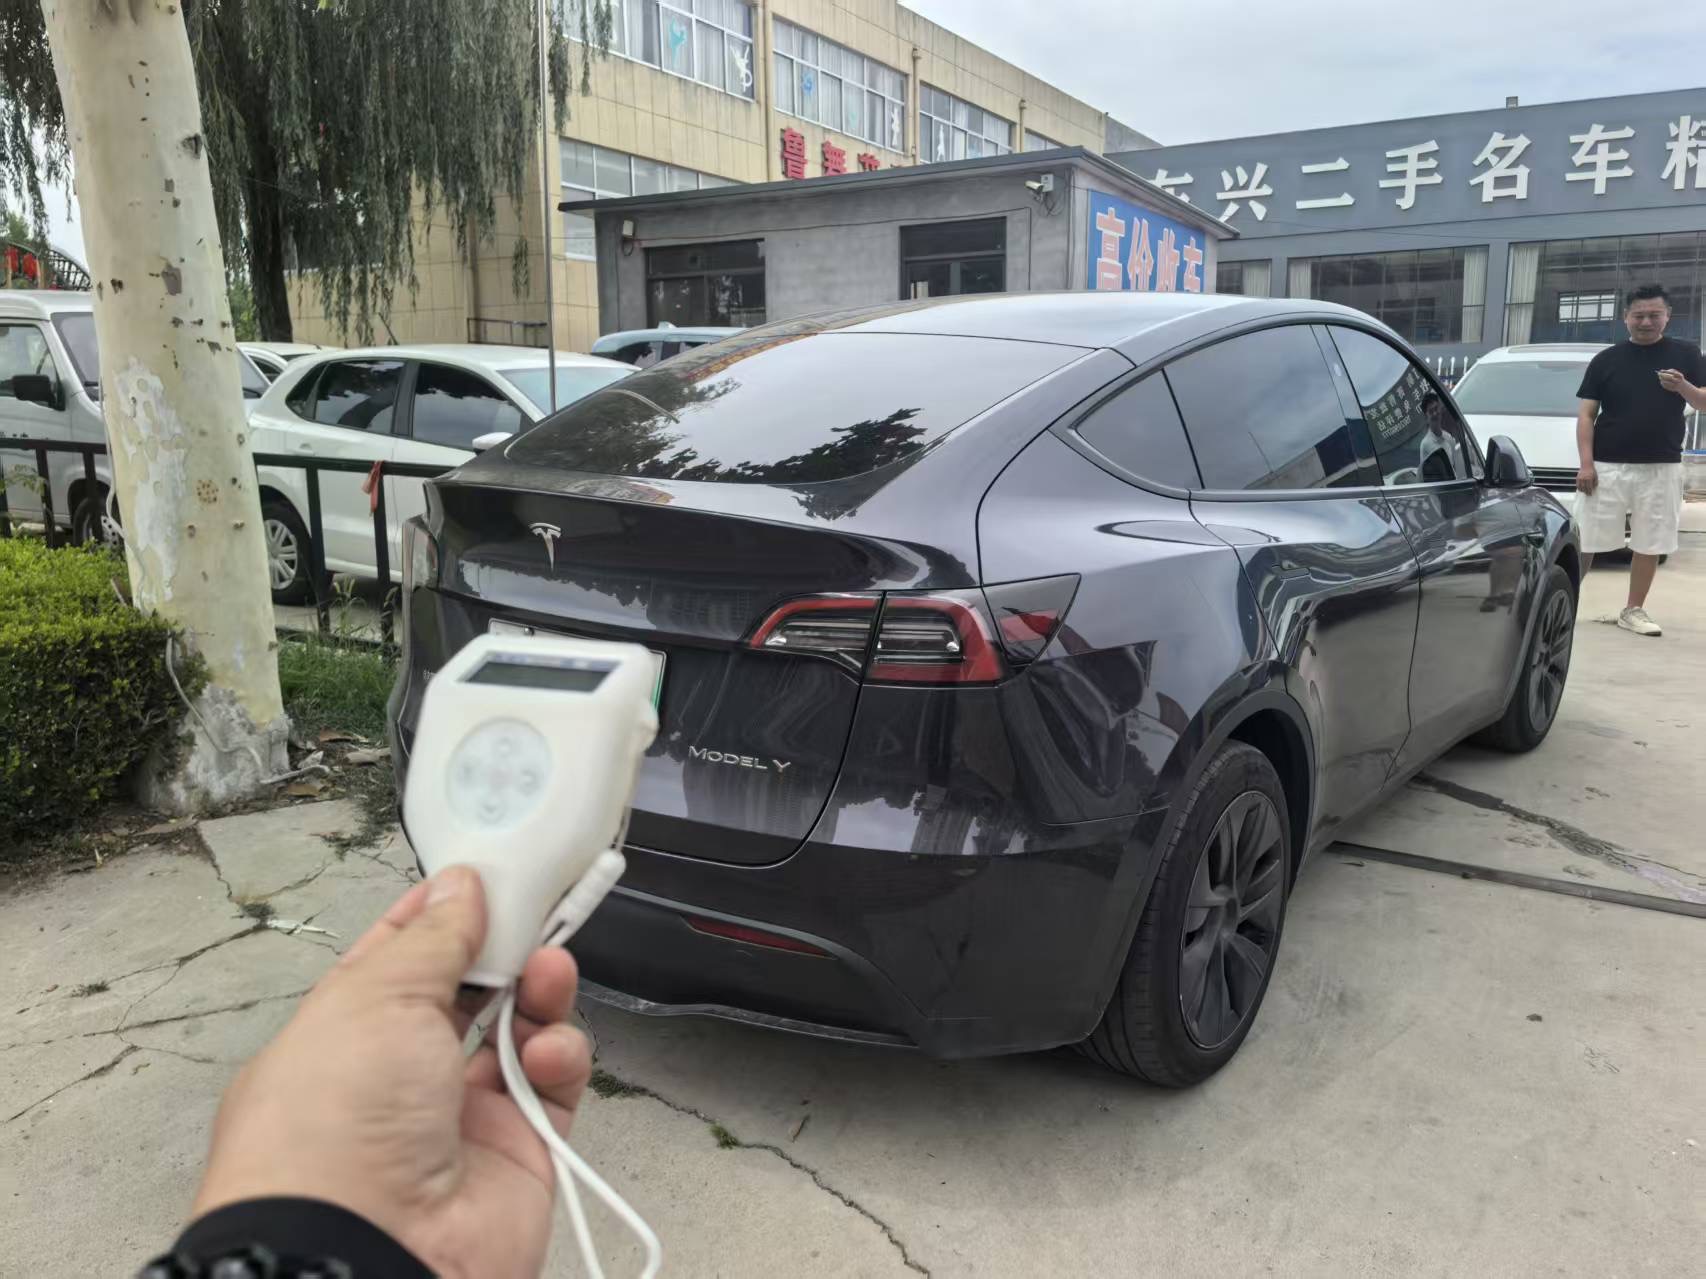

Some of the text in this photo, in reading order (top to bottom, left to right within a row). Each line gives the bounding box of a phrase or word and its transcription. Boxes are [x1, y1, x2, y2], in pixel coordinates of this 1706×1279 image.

[1096, 206, 1203, 292] 高价收车
[688, 745, 791, 773] MODEL Y
